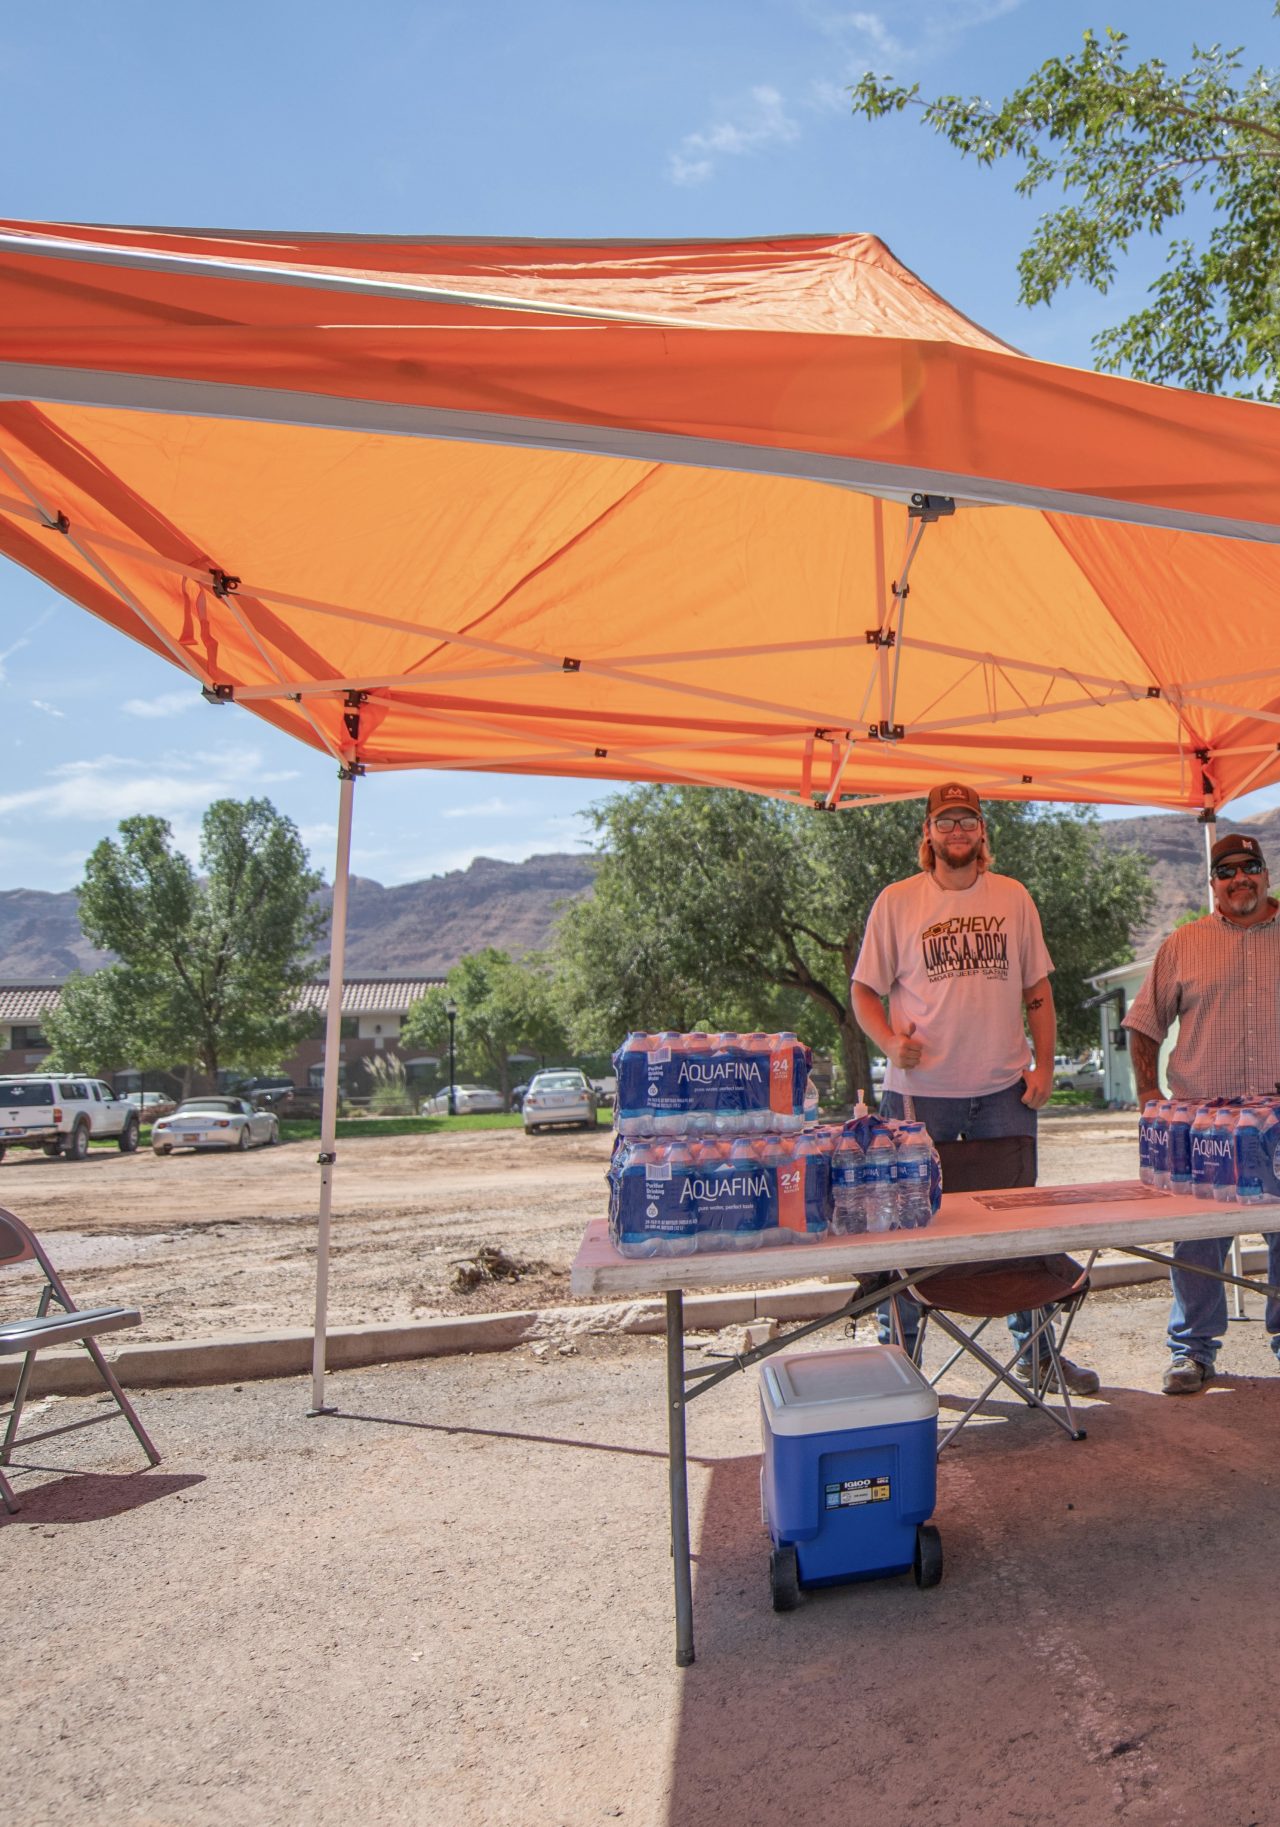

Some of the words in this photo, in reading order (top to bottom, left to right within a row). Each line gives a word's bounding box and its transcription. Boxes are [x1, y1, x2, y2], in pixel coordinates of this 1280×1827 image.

[947, 916, 1006, 934] CHEVY
[922, 935, 960, 970] LIKES
[962, 933, 972, 961] A
[975, 932, 1008, 961] ROCK
[929, 972, 954, 983] MOAB
[956, 969, 980, 977] JEEP
[678, 1061, 762, 1084] AQUAFINA
[772, 1059, 788, 1072] 24
[781, 1170, 800, 1186] 24
[680, 1175, 771, 1204] AQUAFINA
[844, 1479, 871, 1488] IGLOO
